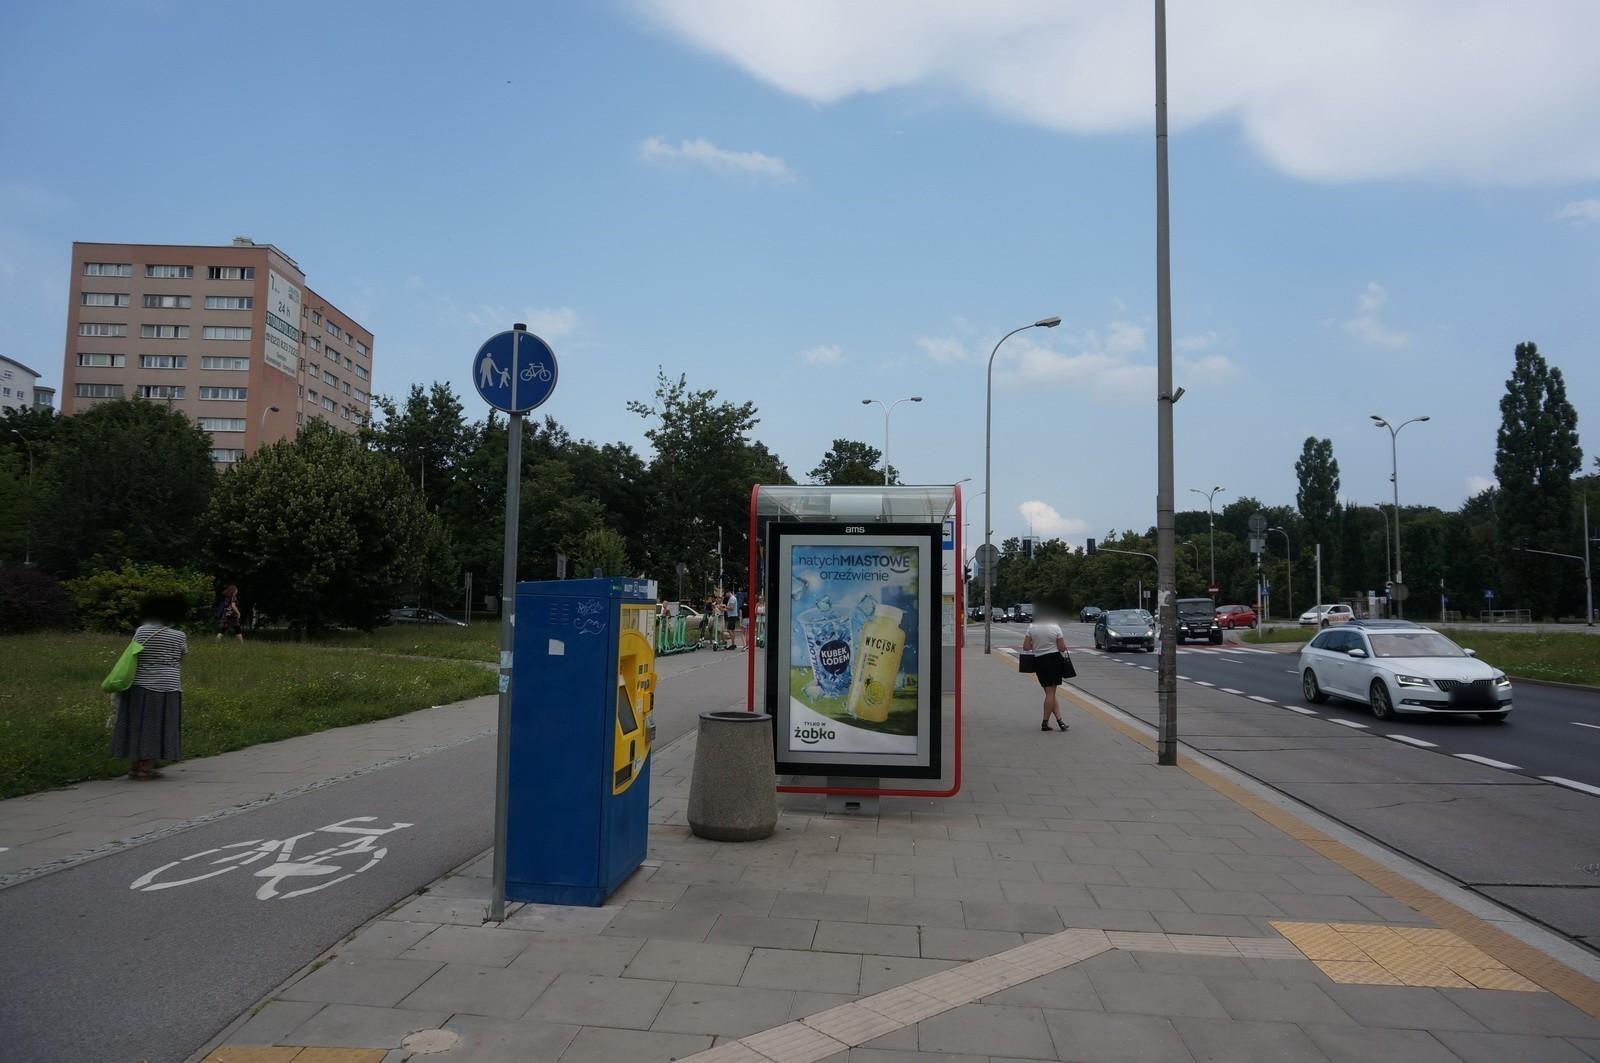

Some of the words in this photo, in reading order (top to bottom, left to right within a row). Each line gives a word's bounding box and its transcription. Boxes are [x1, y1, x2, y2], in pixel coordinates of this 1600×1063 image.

[278, 301, 286, 314] 24
[845, 526, 865, 534] ams
[798, 554, 911, 569] natychMIASTOWE
[819, 568, 889, 582] orzeźwienie
[821, 646, 847, 658] KUBEK
[794, 726, 836, 740] żabka
